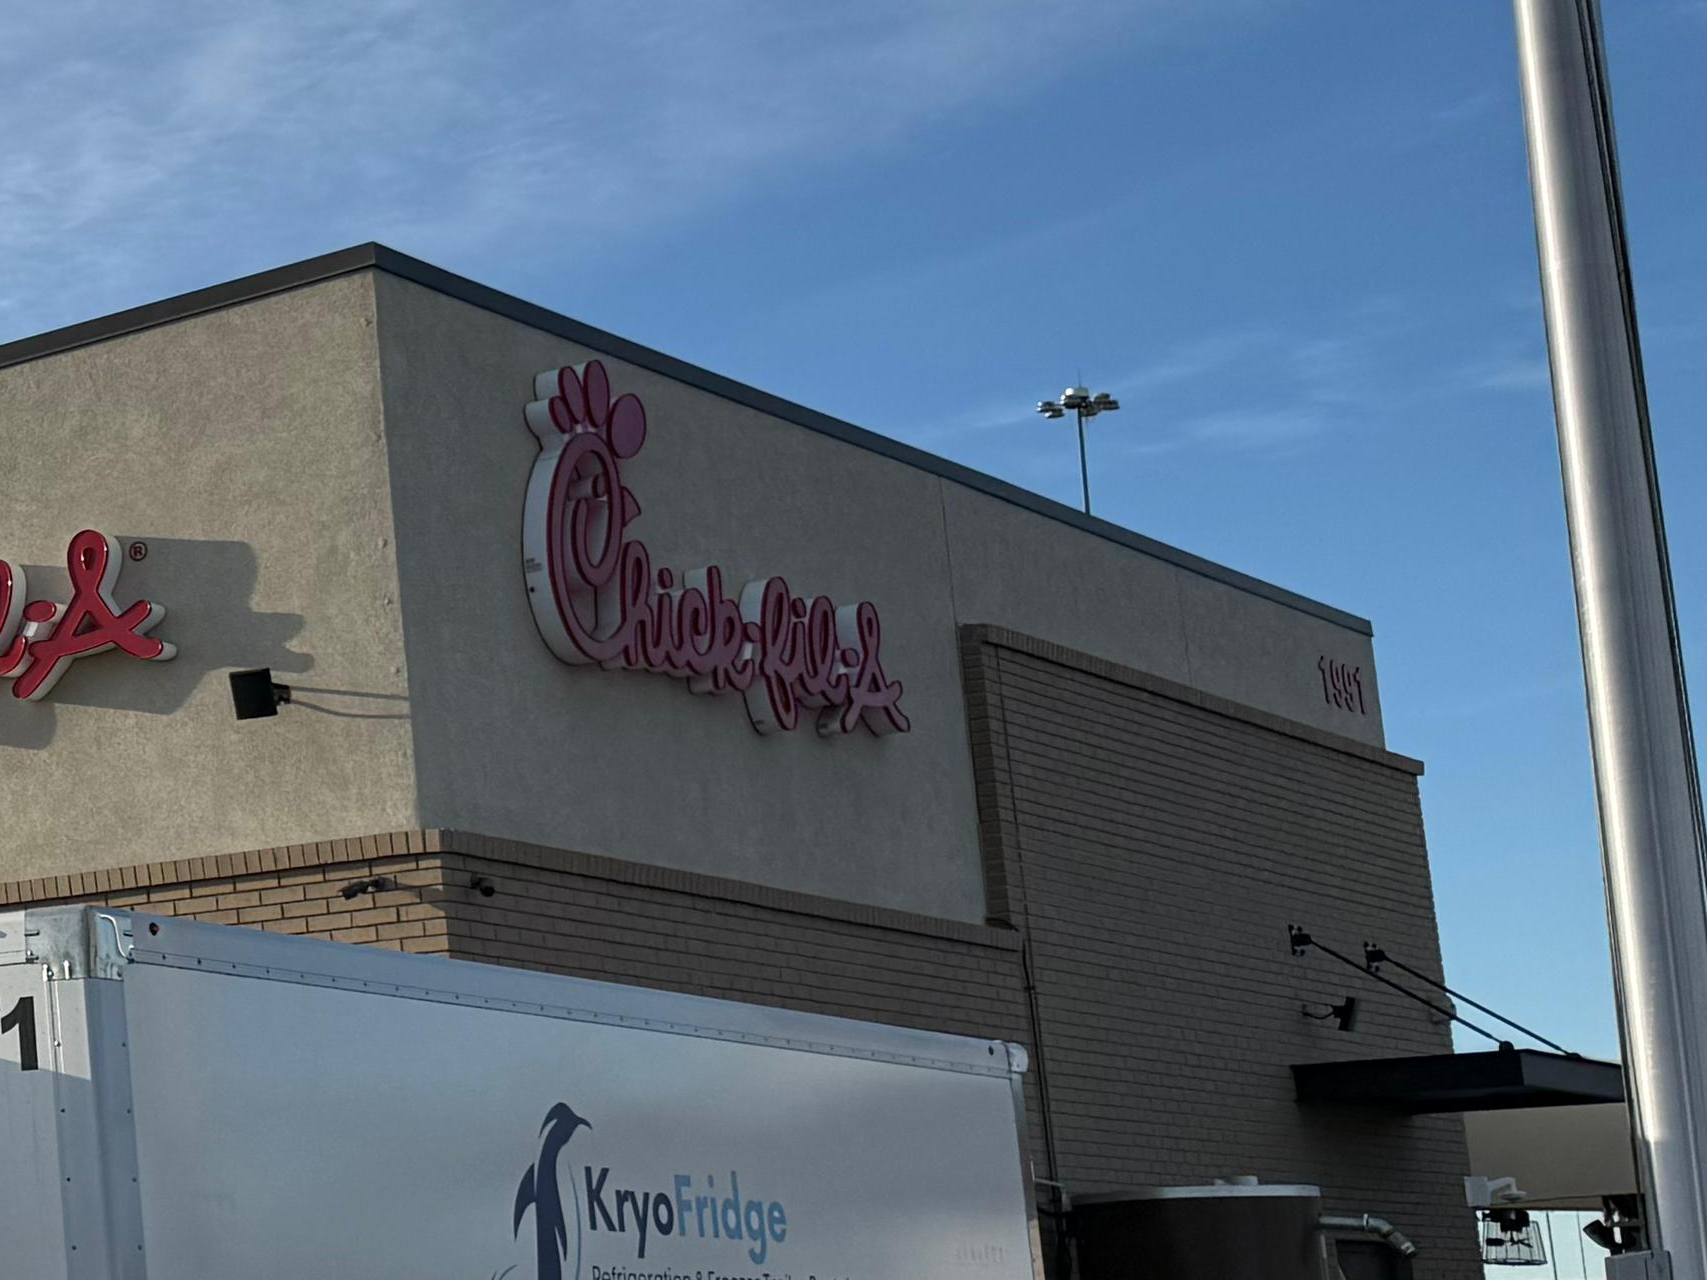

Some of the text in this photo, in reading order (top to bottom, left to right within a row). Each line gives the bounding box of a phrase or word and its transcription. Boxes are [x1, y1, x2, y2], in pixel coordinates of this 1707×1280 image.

[523, 430, 911, 736] Chick-fil-A
[1317, 655, 1366, 716] 1991
[584, 1166, 787, 1265] KryoFridge
